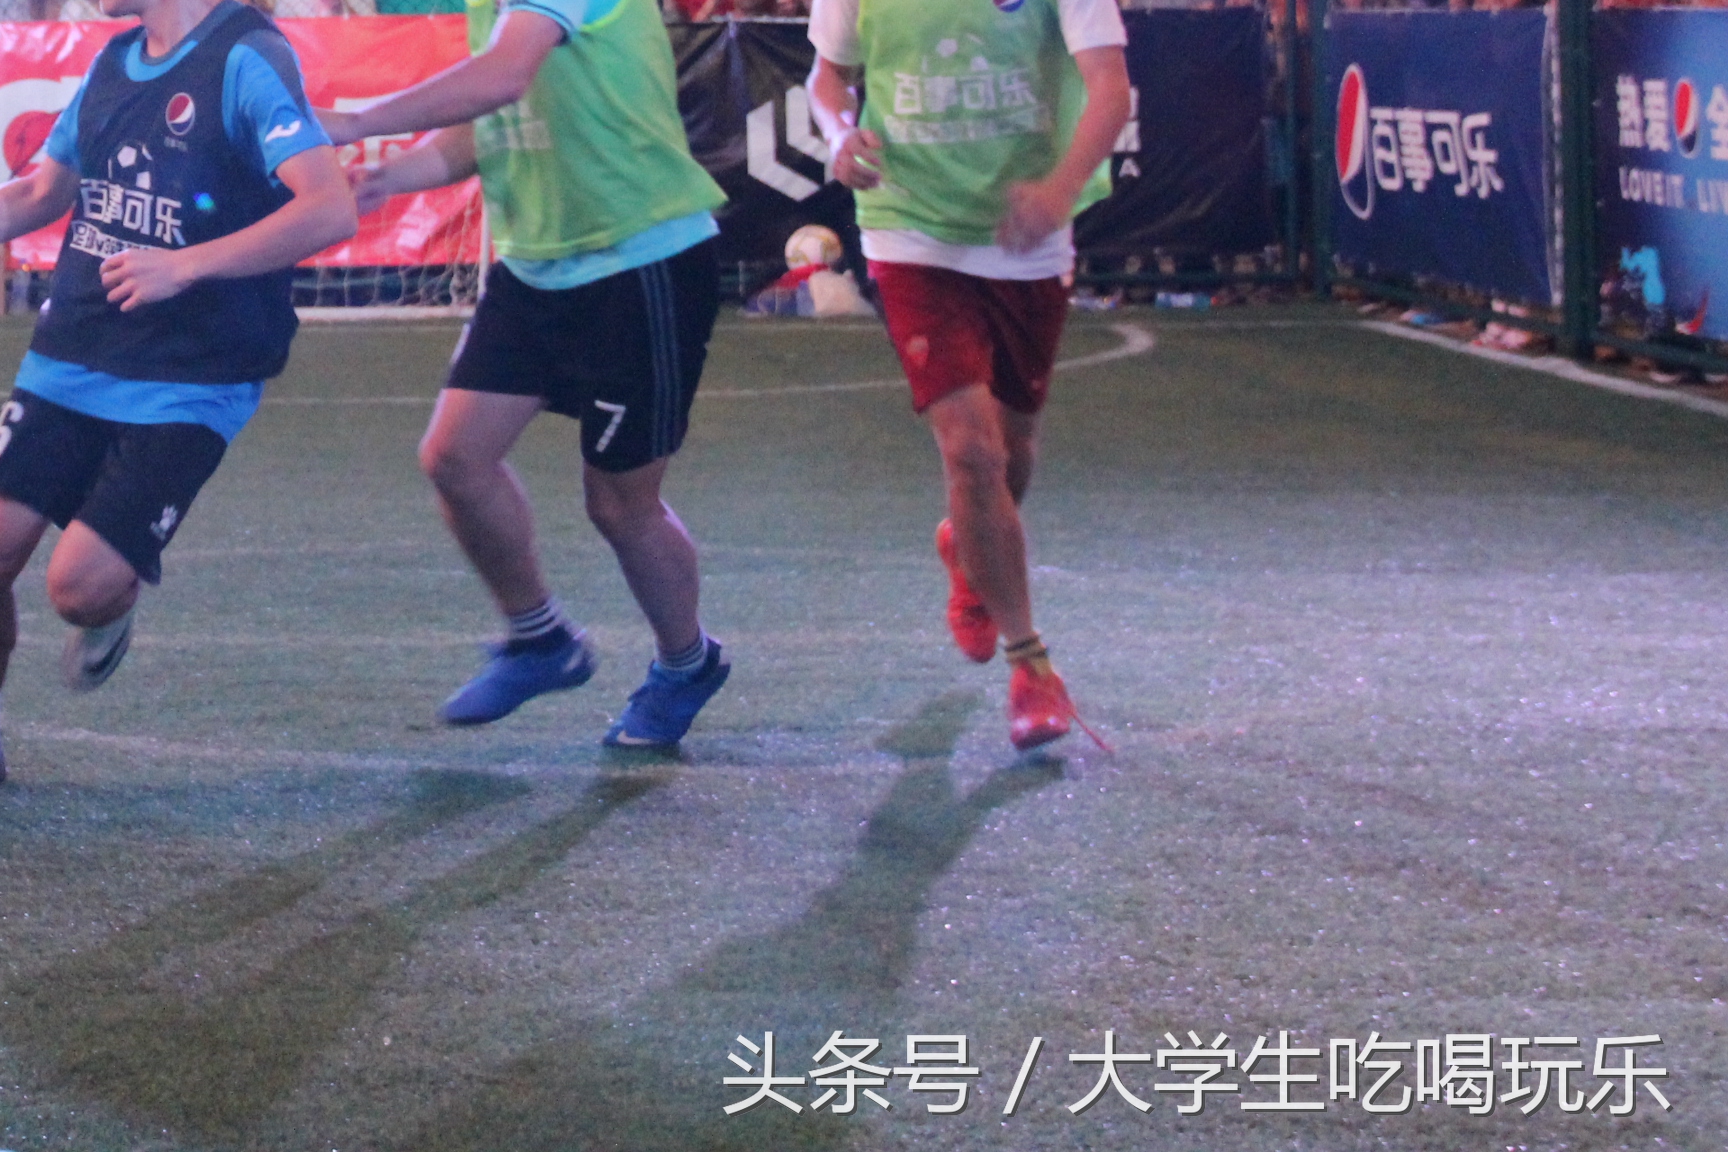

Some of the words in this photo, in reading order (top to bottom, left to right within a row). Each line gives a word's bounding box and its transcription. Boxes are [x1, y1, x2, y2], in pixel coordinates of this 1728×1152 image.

[892, 68, 1040, 116] 百事可乐
[1370, 105, 1505, 200] 百事可乐
[79, 177, 187, 247] 百事可乐
[594, 399, 626, 453] 7
